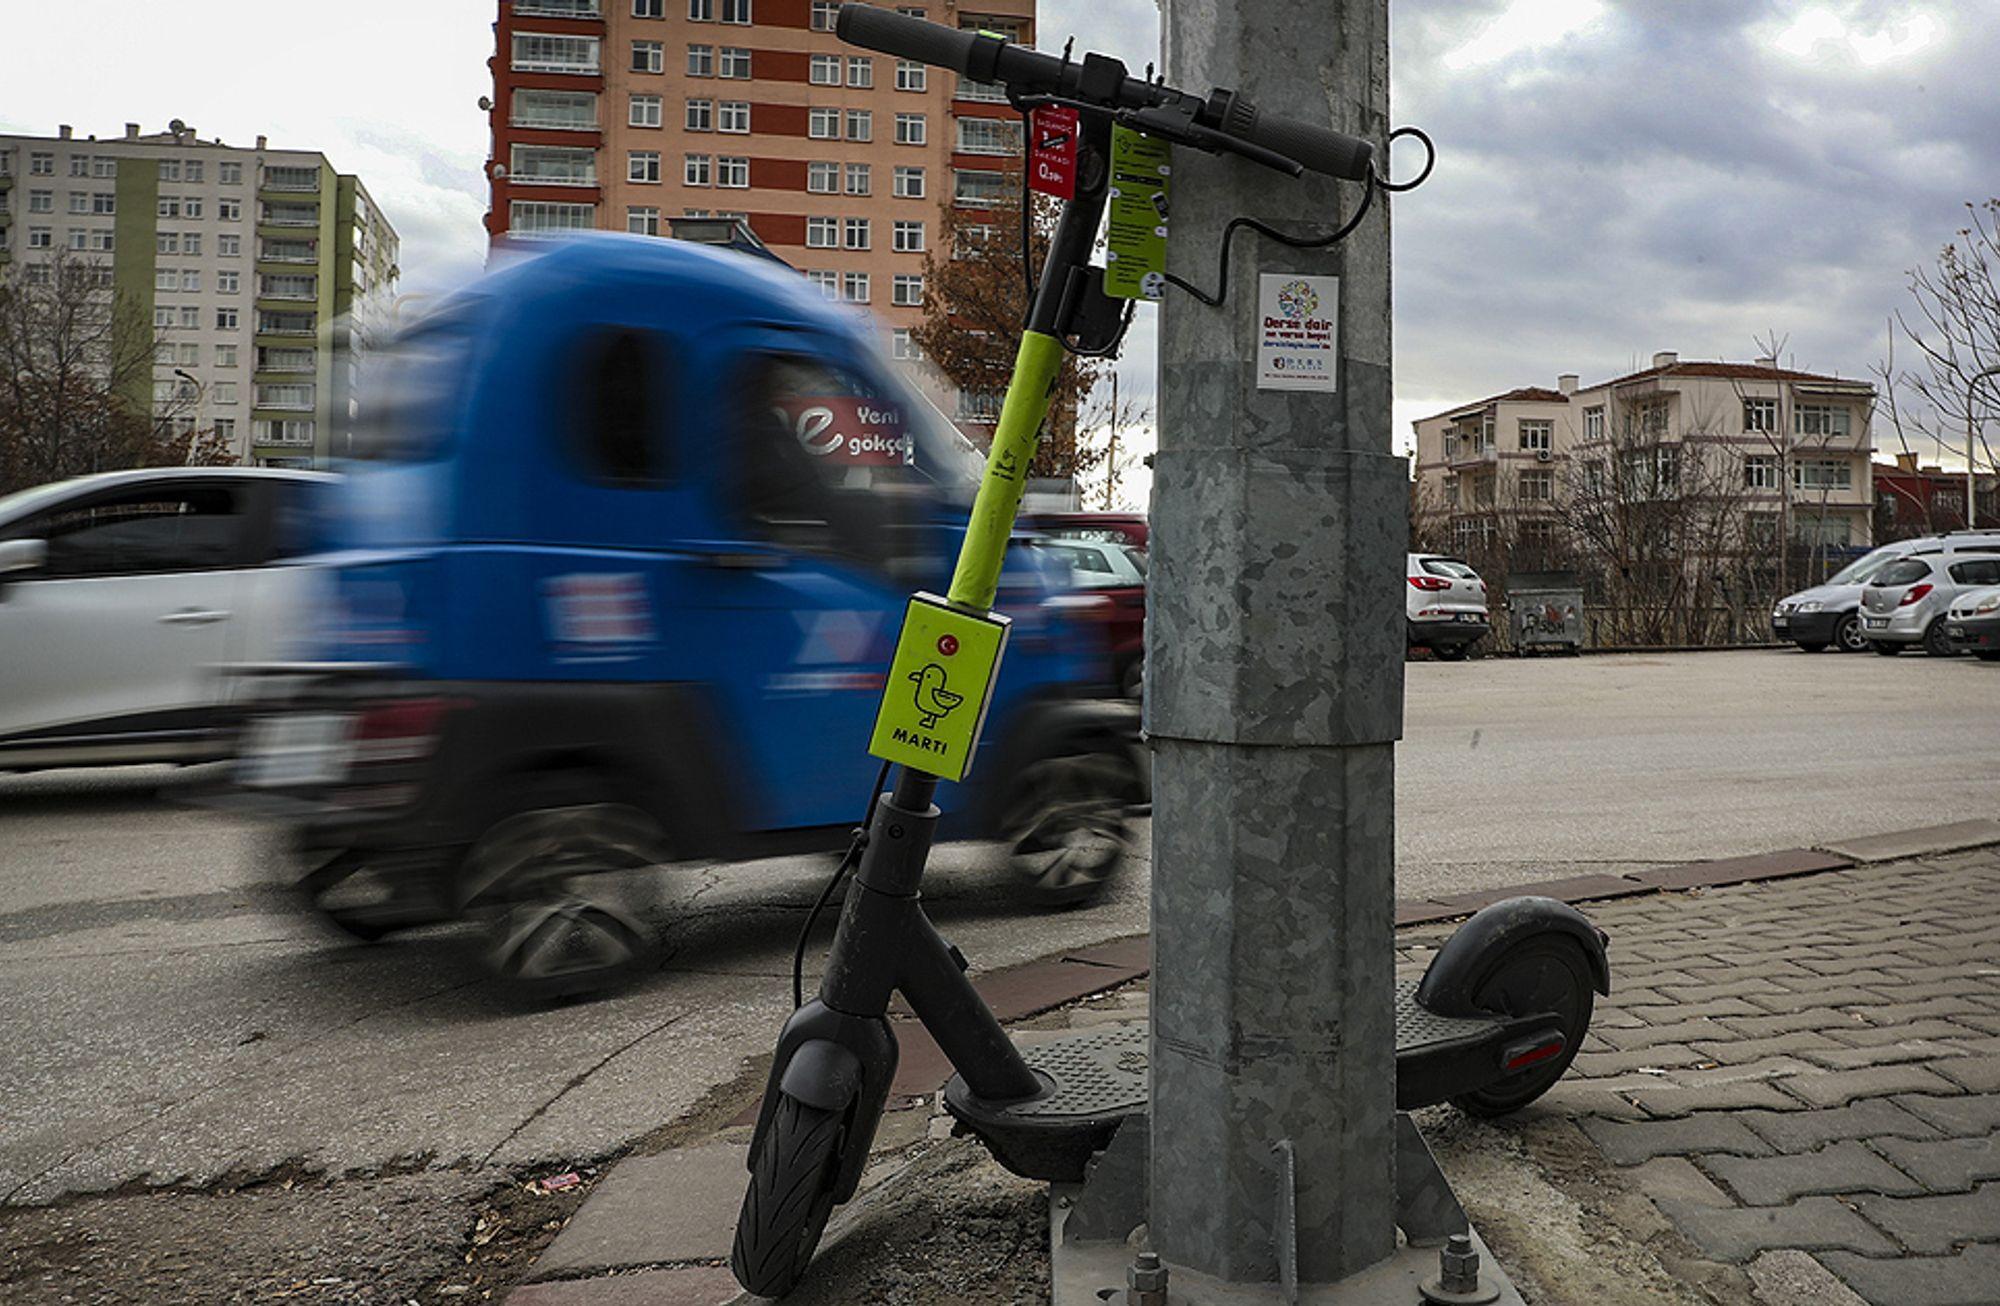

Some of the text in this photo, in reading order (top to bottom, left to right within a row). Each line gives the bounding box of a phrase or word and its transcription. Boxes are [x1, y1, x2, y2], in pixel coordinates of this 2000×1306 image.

[1305, 317, 1333, 331] dair
[856, 406, 899, 424] Yeni
[892, 728, 947, 755] MARTI
